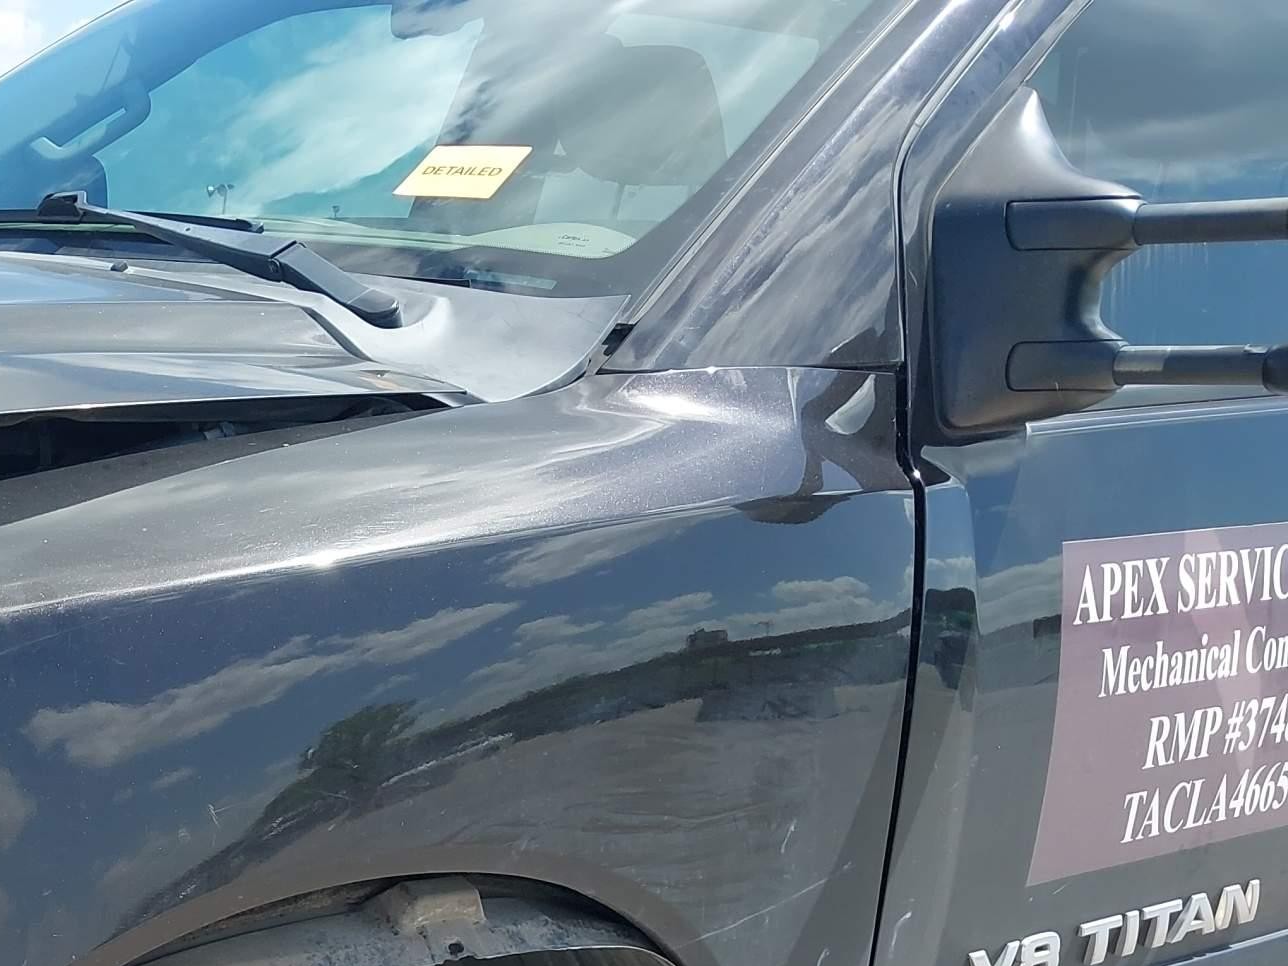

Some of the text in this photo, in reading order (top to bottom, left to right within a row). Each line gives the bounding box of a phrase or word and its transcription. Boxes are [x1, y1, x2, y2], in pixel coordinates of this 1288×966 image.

[421, 165, 503, 177] DETAILED
[1073, 543, 1288, 626] APEX SERVIC
[1099, 630, 1241, 698] Mechanical
[1141, 693, 1288, 770] RMP #374
[1078, 879, 1261, 966] TITAN
